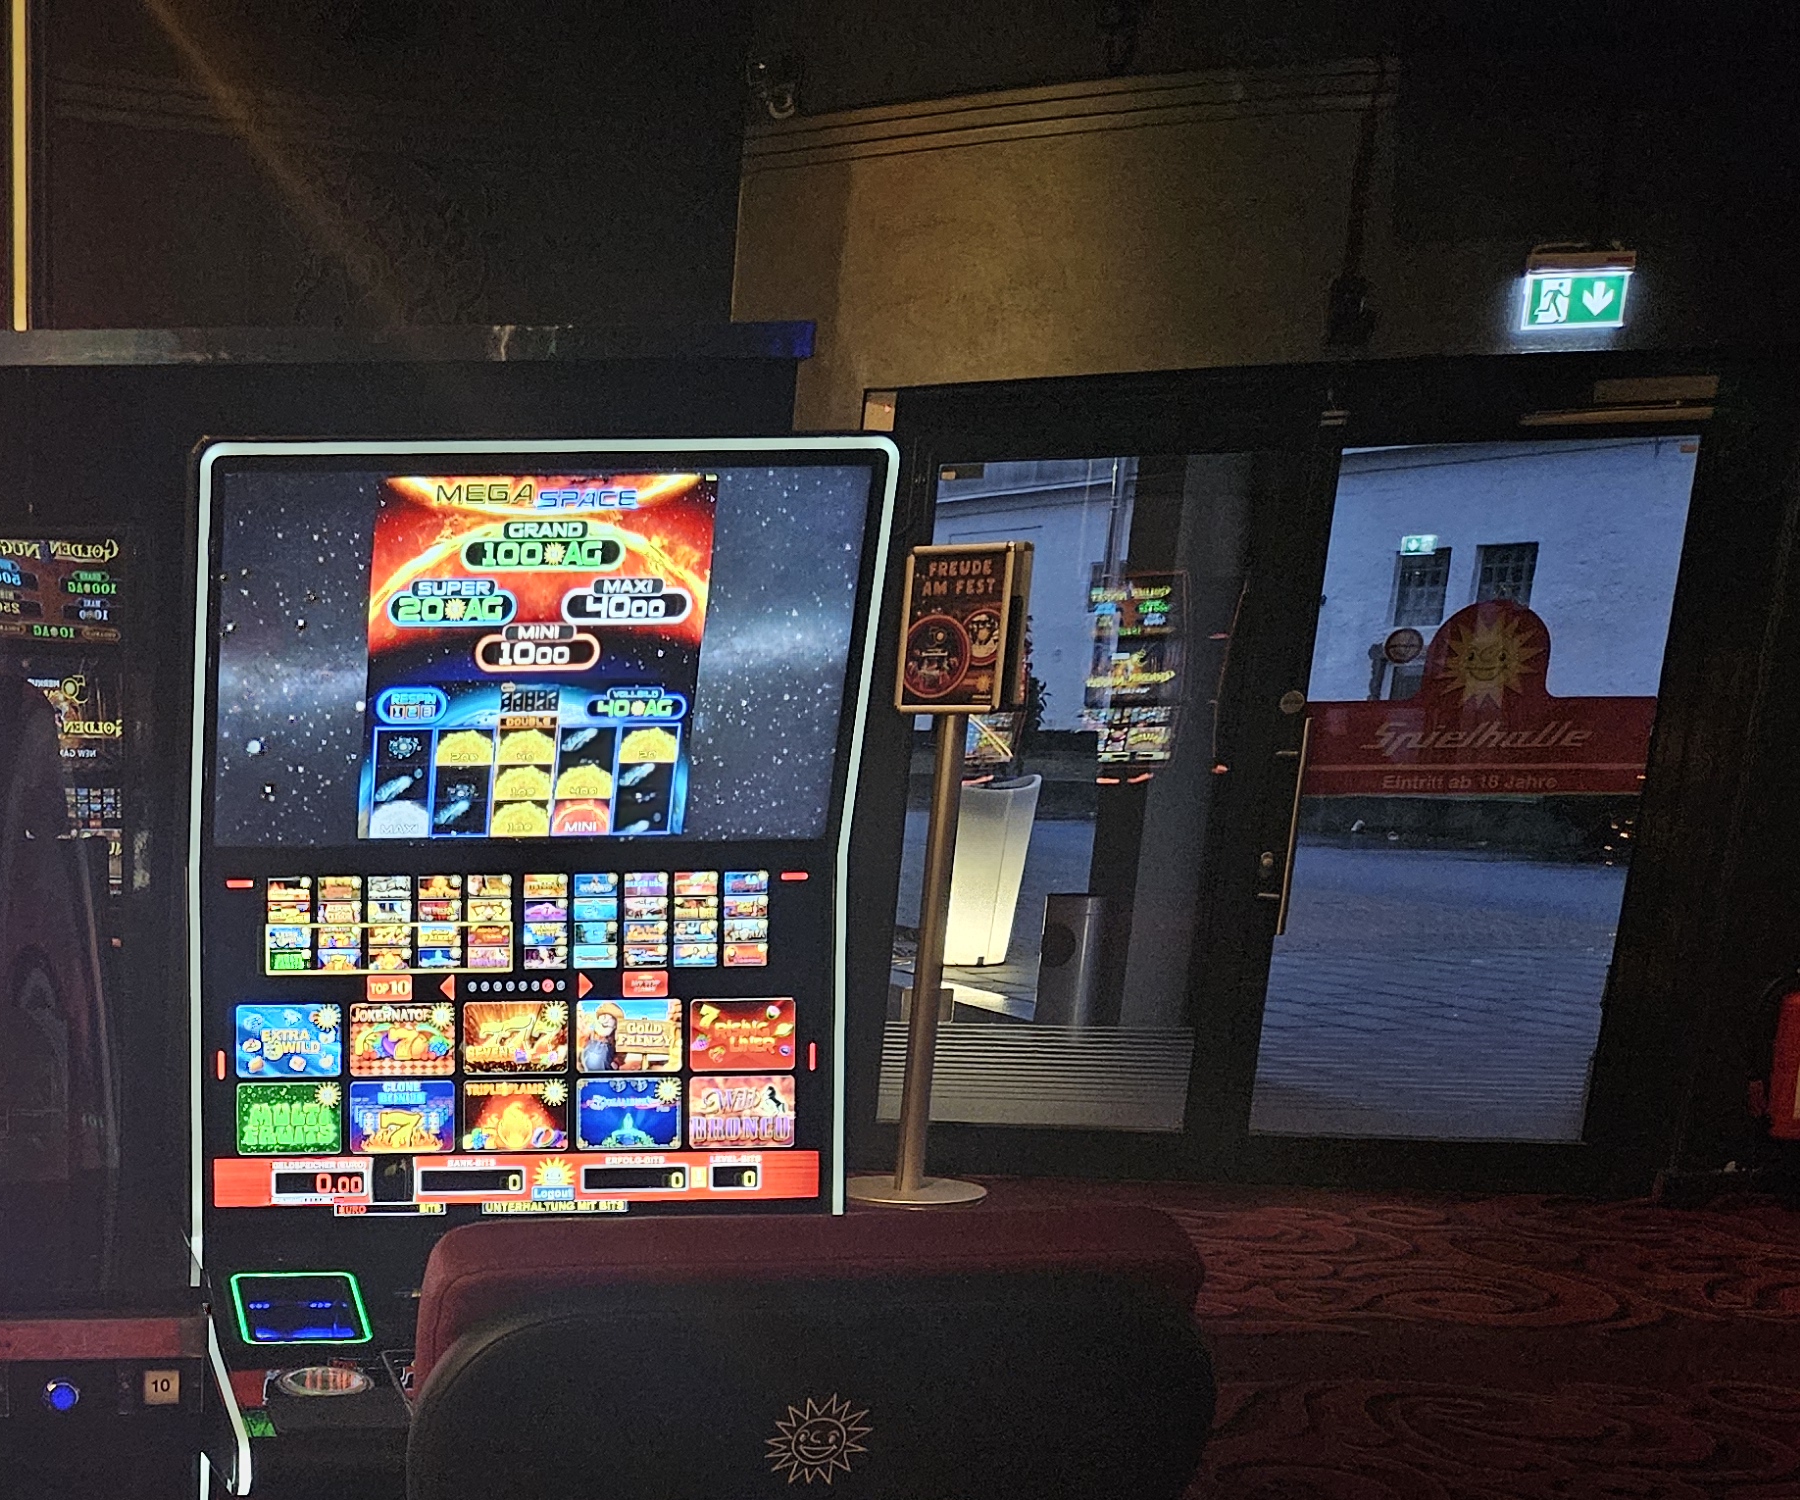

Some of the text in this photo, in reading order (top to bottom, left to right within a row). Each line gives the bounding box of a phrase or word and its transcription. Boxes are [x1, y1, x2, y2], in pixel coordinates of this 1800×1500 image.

[436, 483, 638, 509] MEGA SPACE
[508, 523, 583, 538] GRAND
[481, 542, 543, 566] 100
[929, 559, 992, 577] FREUDE
[417, 581, 491, 595] SUPER
[603, 579, 653, 593] MAXI
[922, 578, 995, 596] AM FEST
[398, 598, 444, 621] 20
[518, 625, 560, 639] MINI
[597, 700, 630, 717] 40
[1360, 721, 1594, 757] Spielhalle
[1381, 774, 1558, 790] Eintritt ab 18 Jahre
[564, 821, 597, 832] MINI
[370, 980, 410, 996] TOP 10
[261, 1028, 310, 1042] EXTRA
[616, 1035, 673, 1048] FRENZY
[280, 1041, 321, 1054] WILD
[690, 1116, 791, 1142] BRONCO
[315, 1173, 363, 1193] 0.00
[507, 1174, 522, 1191] 0
[670, 1171, 684, 1188] 0
[743, 1170, 756, 1187] 0
[533, 1187, 574, 1200] Logout
[485, 1201, 576, 1213] UNTERHALTUNG
[151, 1378, 170, 1393] 10
